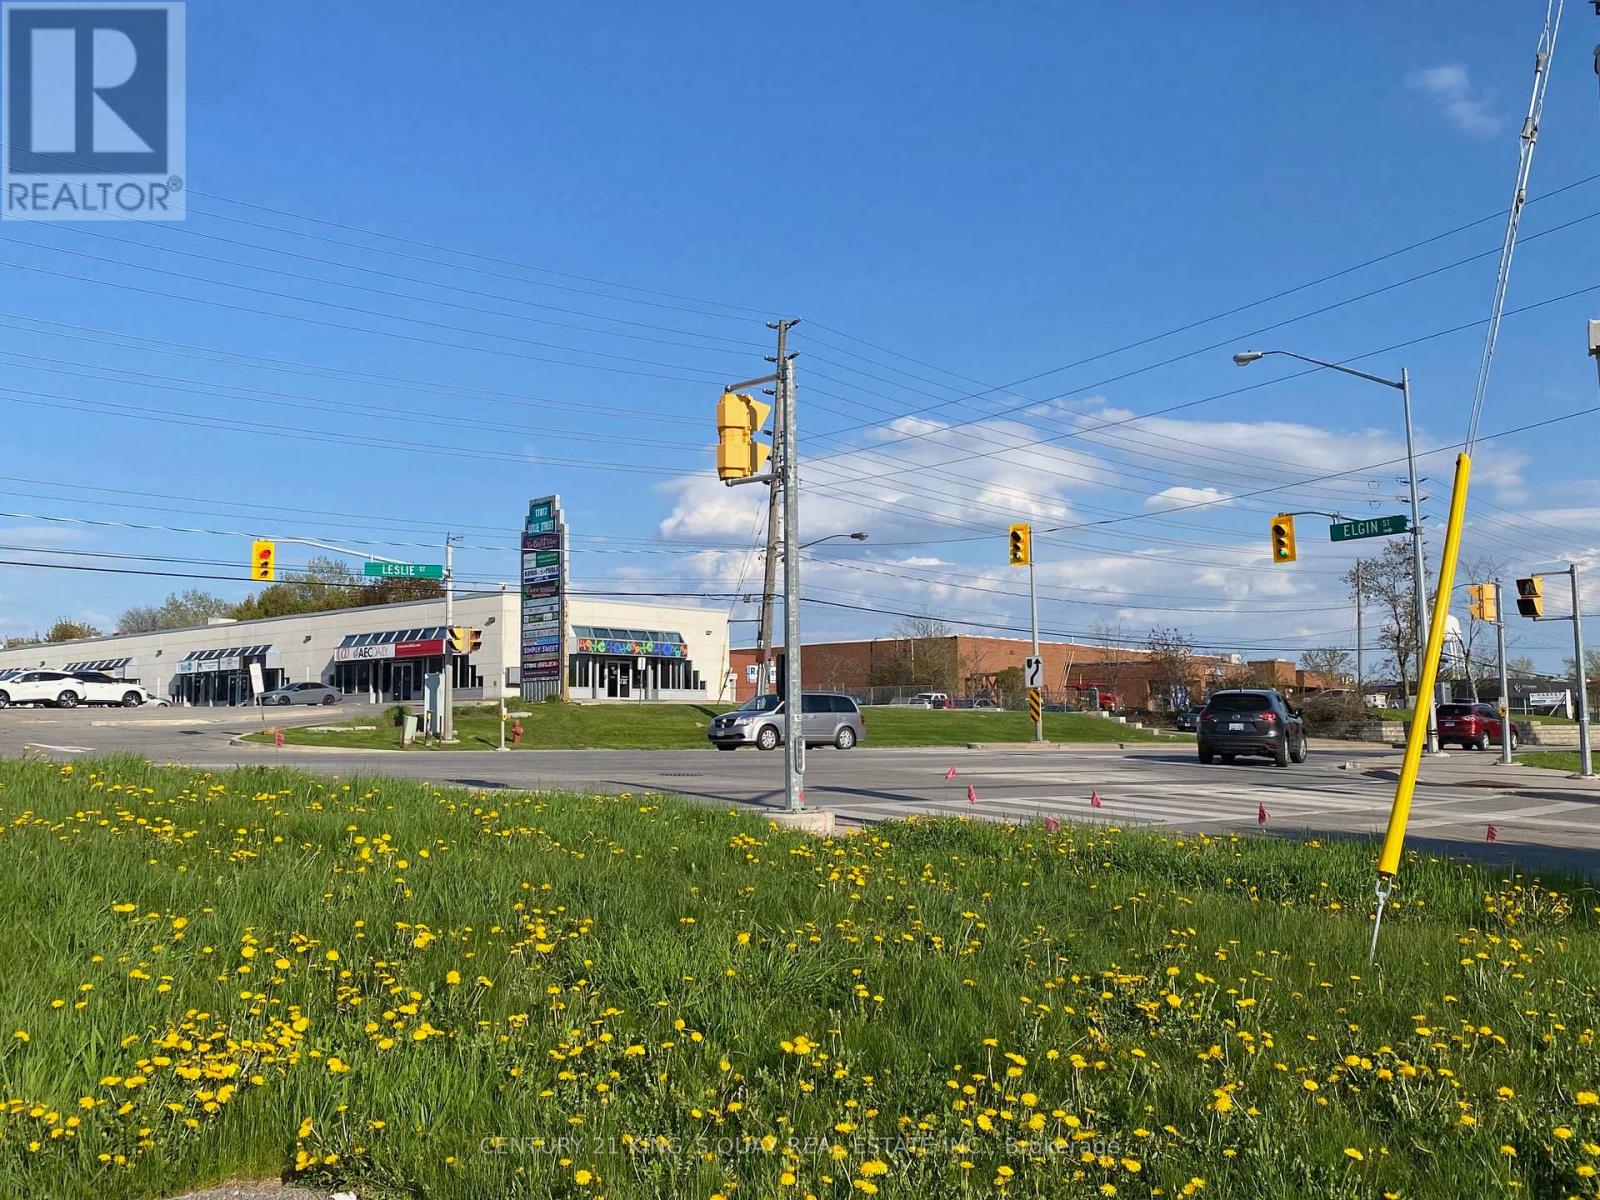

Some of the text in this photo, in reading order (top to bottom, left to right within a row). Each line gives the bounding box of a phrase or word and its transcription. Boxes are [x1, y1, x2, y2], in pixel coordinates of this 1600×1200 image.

[1343, 519, 1390, 537] ELGIN ST
[382, 564, 416, 576] LESLIE
